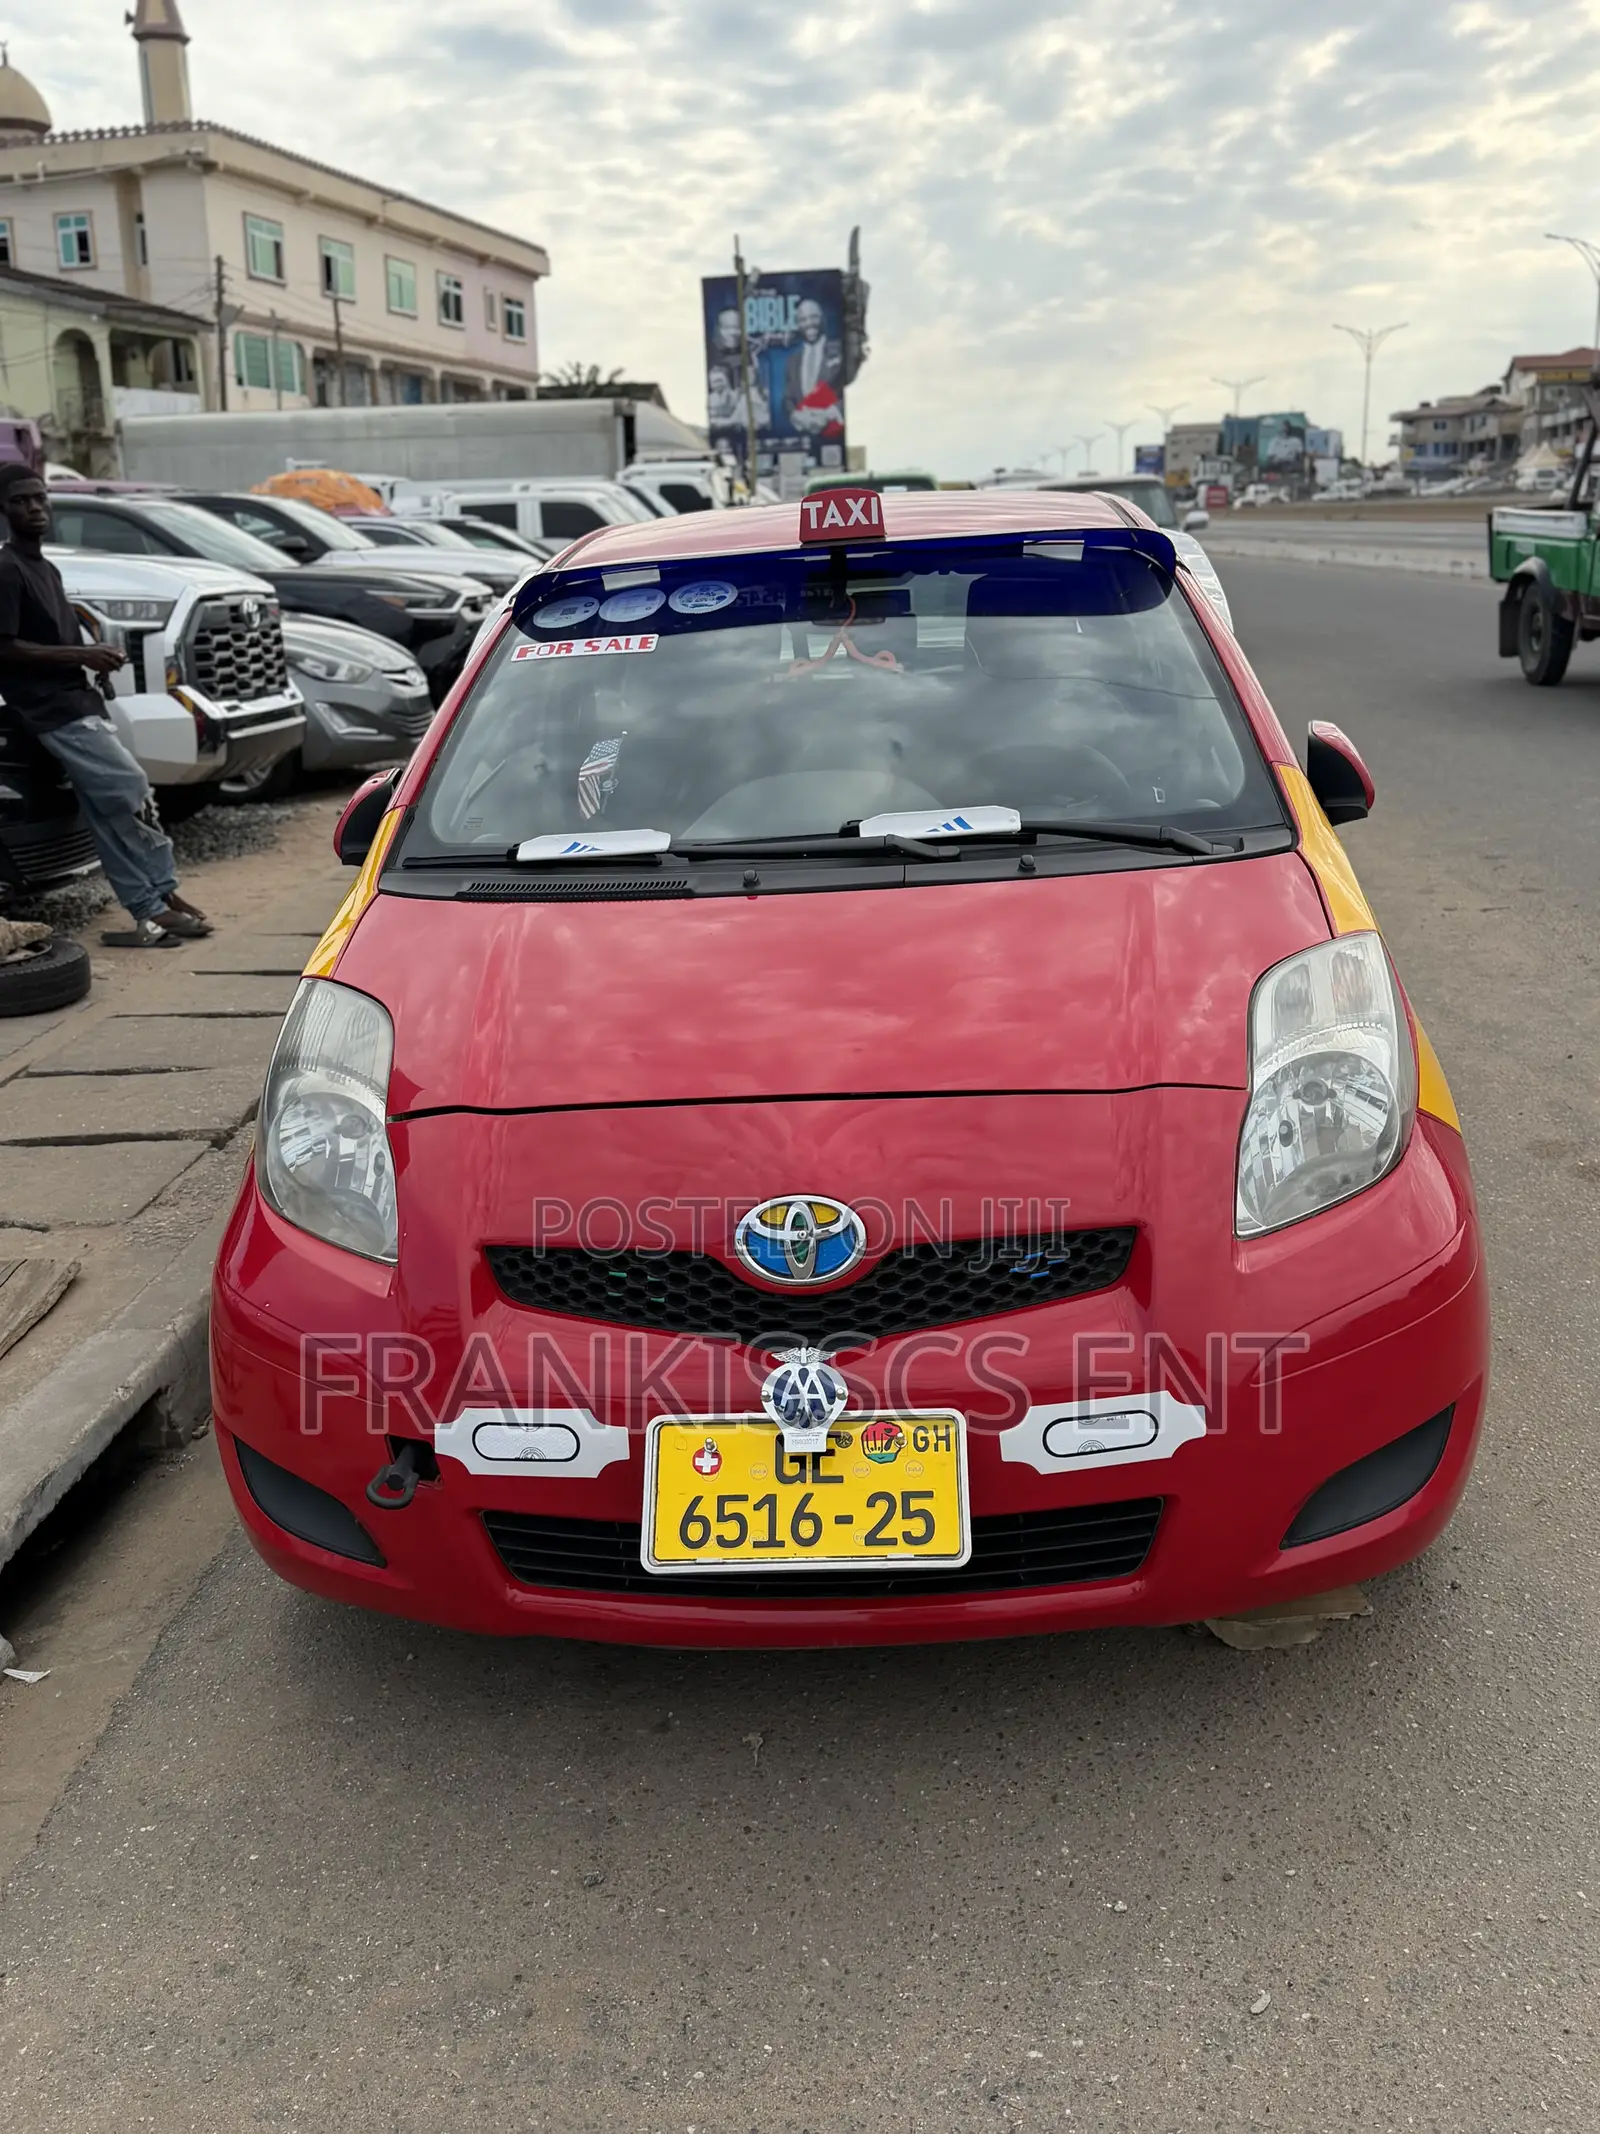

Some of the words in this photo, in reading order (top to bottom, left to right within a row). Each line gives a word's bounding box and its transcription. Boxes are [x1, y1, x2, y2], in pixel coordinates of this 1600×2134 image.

[744, 295, 801, 334] BIBLE
[802, 496, 879, 530] TAXI
[516, 642, 574, 659] FOR
[583, 636, 656, 653] SALE
[780, 1367, 834, 1414] AA
[775, 1431, 844, 1485] GE
[912, 1424, 951, 1453] GH
[679, 1490, 937, 1550] 6516-25
